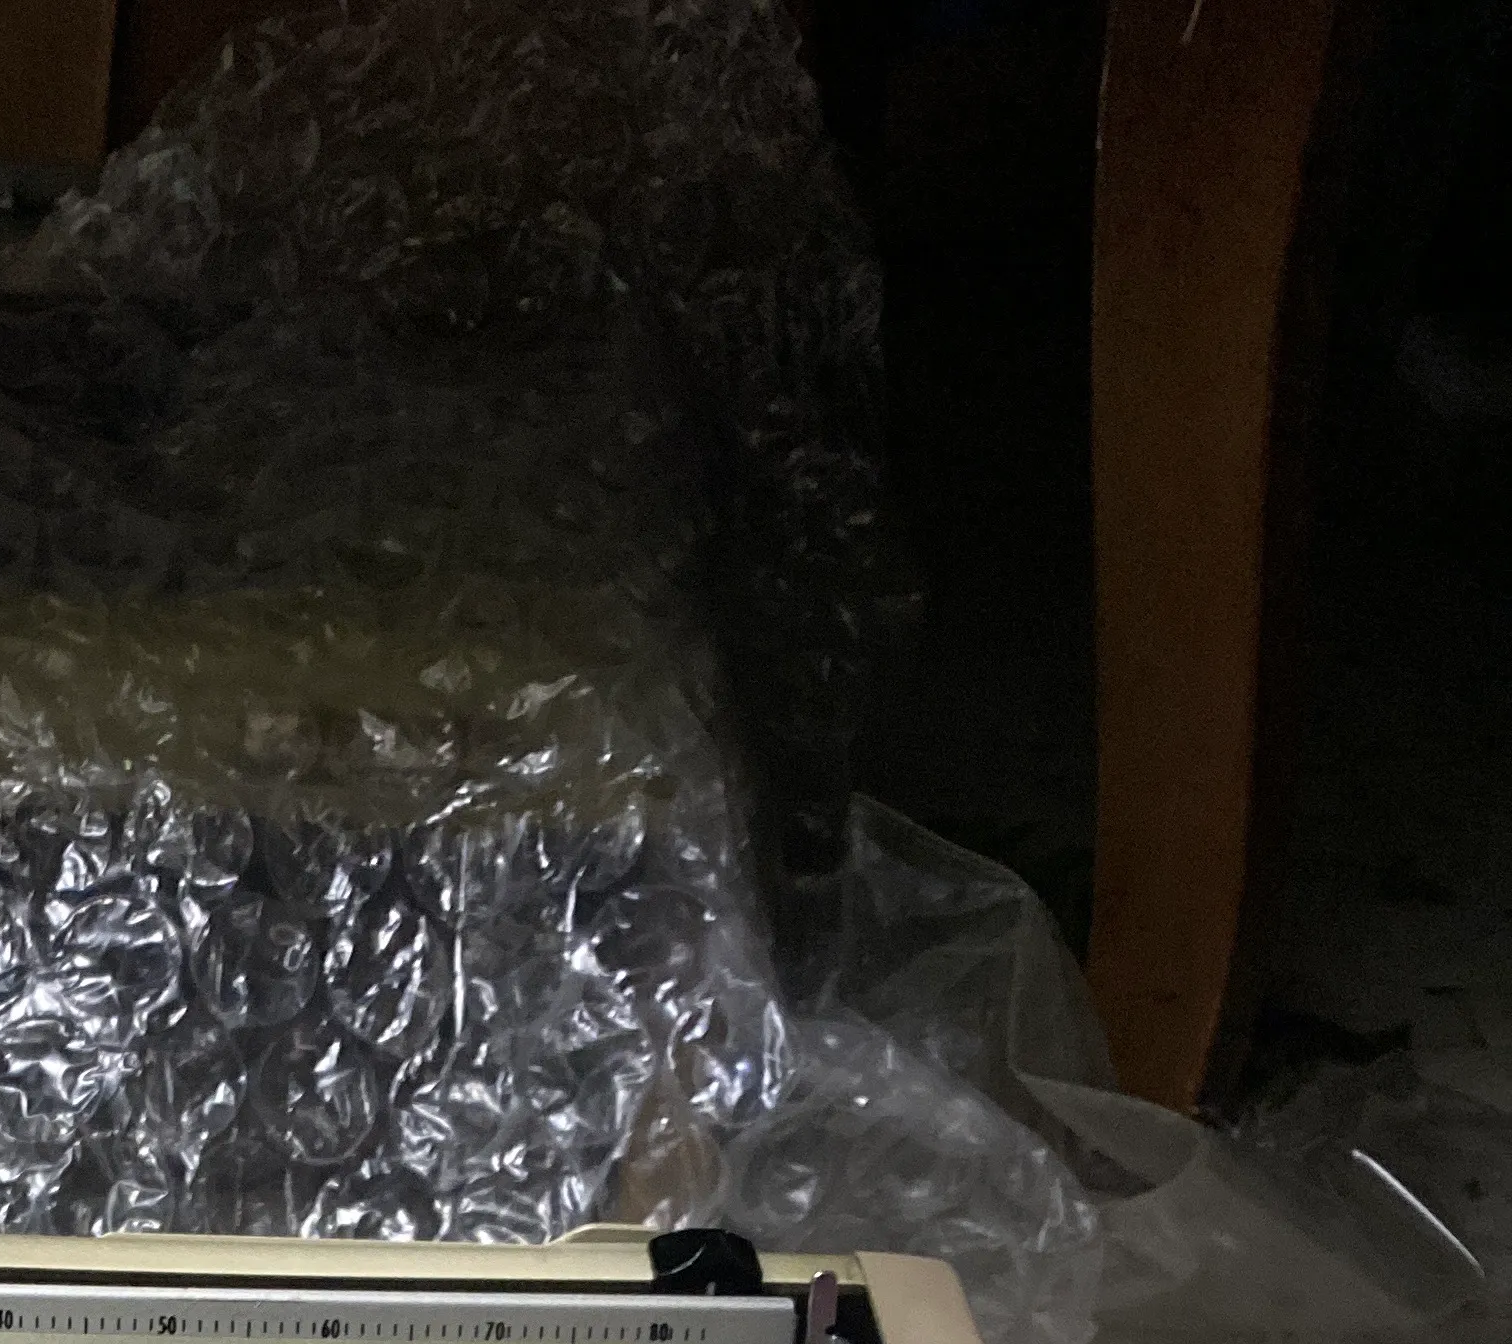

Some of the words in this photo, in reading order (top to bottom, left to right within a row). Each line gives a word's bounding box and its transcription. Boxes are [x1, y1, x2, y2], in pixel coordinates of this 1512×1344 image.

[156, 1315, 177, 1335] 50
[321, 1319, 340, 1338] 60
[485, 1321, 505, 1341] 70
[649, 1323, 669, 1341] 80
